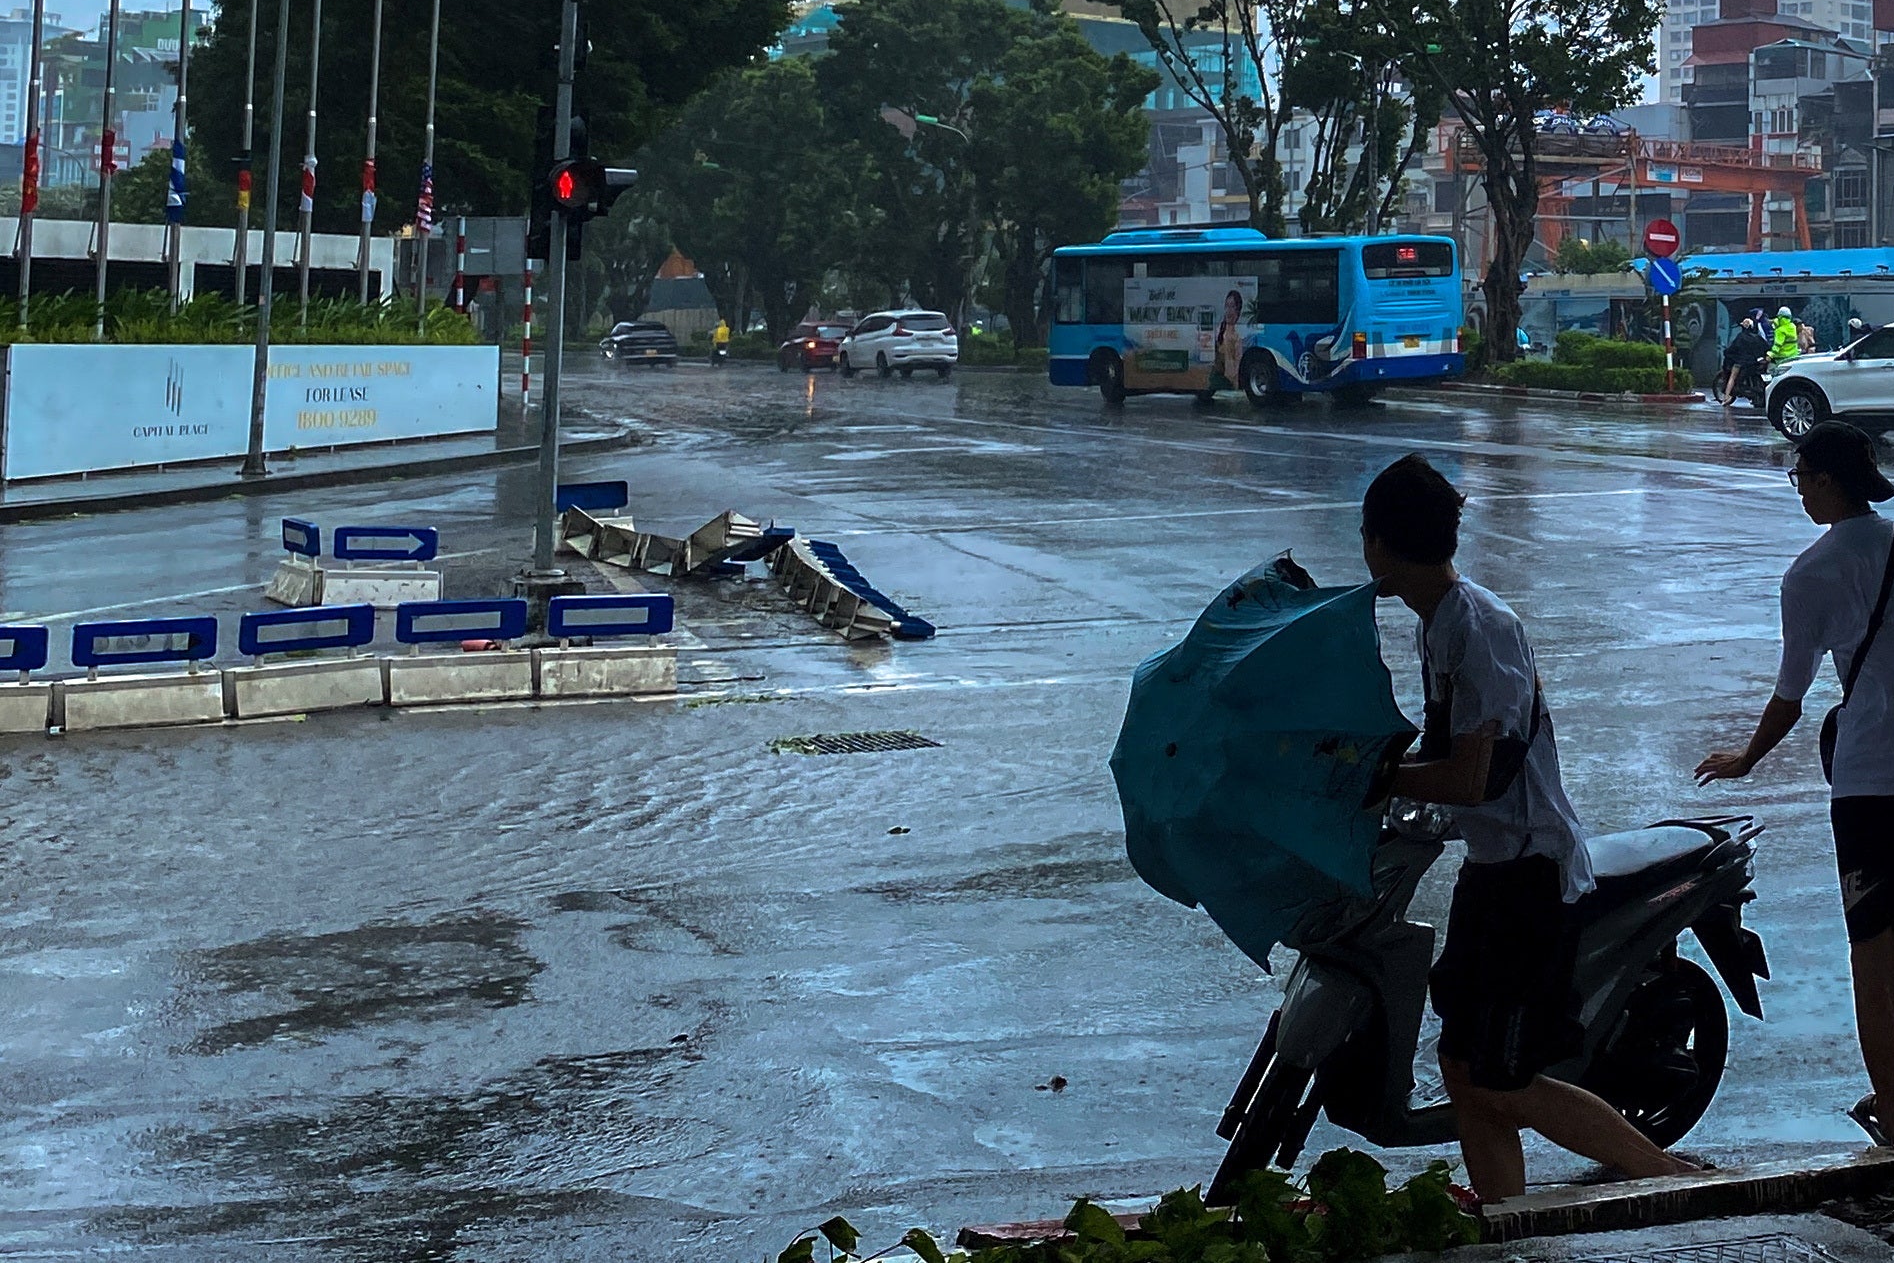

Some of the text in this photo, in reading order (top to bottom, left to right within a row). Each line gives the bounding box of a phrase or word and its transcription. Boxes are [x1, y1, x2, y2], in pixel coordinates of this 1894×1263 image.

[309, 363, 333, 377] AND
[336, 362, 372, 377] RETAIL
[378, 361, 410, 376] SPACE
[306, 386, 369, 403] FOR LEASE
[297, 409, 377, 430] 1800 9289
[133, 424, 209, 437] CAPITAL PLACE
